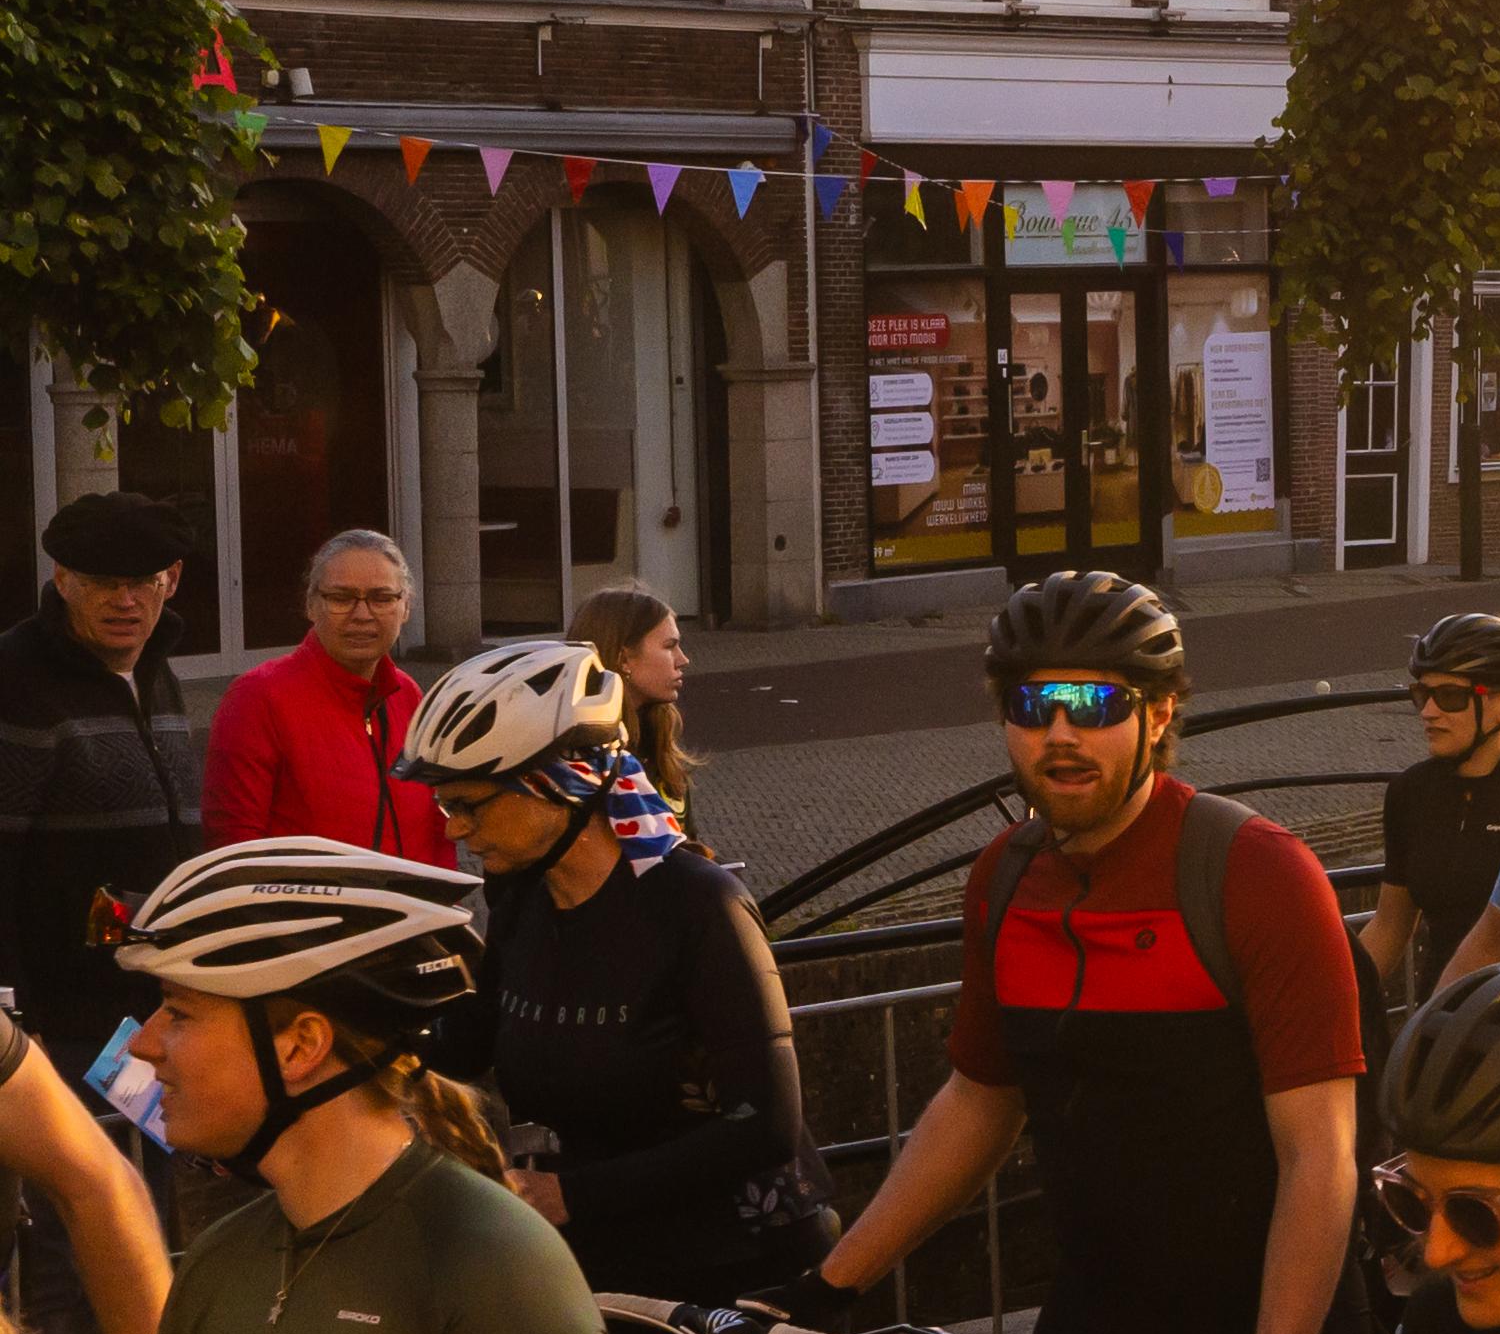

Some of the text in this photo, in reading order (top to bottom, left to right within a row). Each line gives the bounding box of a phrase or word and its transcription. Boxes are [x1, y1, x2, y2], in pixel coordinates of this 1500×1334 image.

[888, 318, 908, 331] PLEK
[911, 318, 918, 330] IS
[921, 317, 946, 330] KLAAR
[890, 333, 908, 345] IETS
[248, 436, 298, 455] HEMA
[963, 482, 987, 495] MAAK
[957, 496, 988, 509] WINKEL
[926, 509, 989, 527] WERKELIJKHEID
[251, 884, 342, 897] ROGELLI
[556, 1003, 628, 1026] BROS
